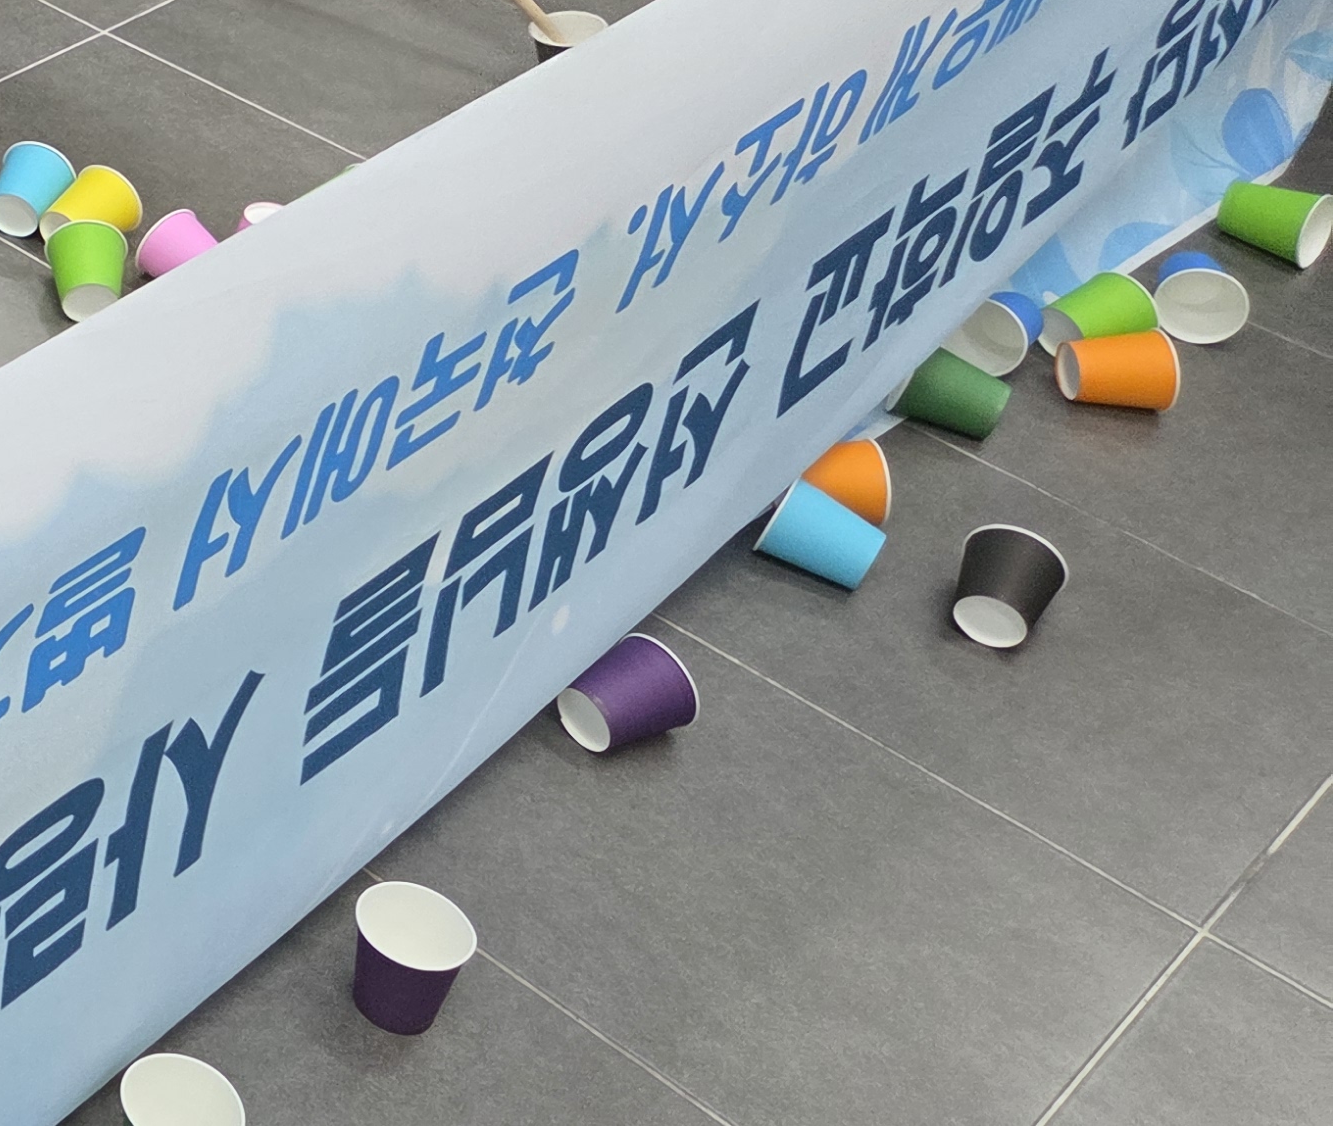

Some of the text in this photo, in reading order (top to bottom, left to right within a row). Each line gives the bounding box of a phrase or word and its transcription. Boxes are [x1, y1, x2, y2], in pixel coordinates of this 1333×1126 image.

[617, 69, 867, 312] 하소서.
[776, 47, 1117, 419] 주일학교
[173, 250, 578, 610] 천국에서
[299, 299, 761, 786] 선생님들
